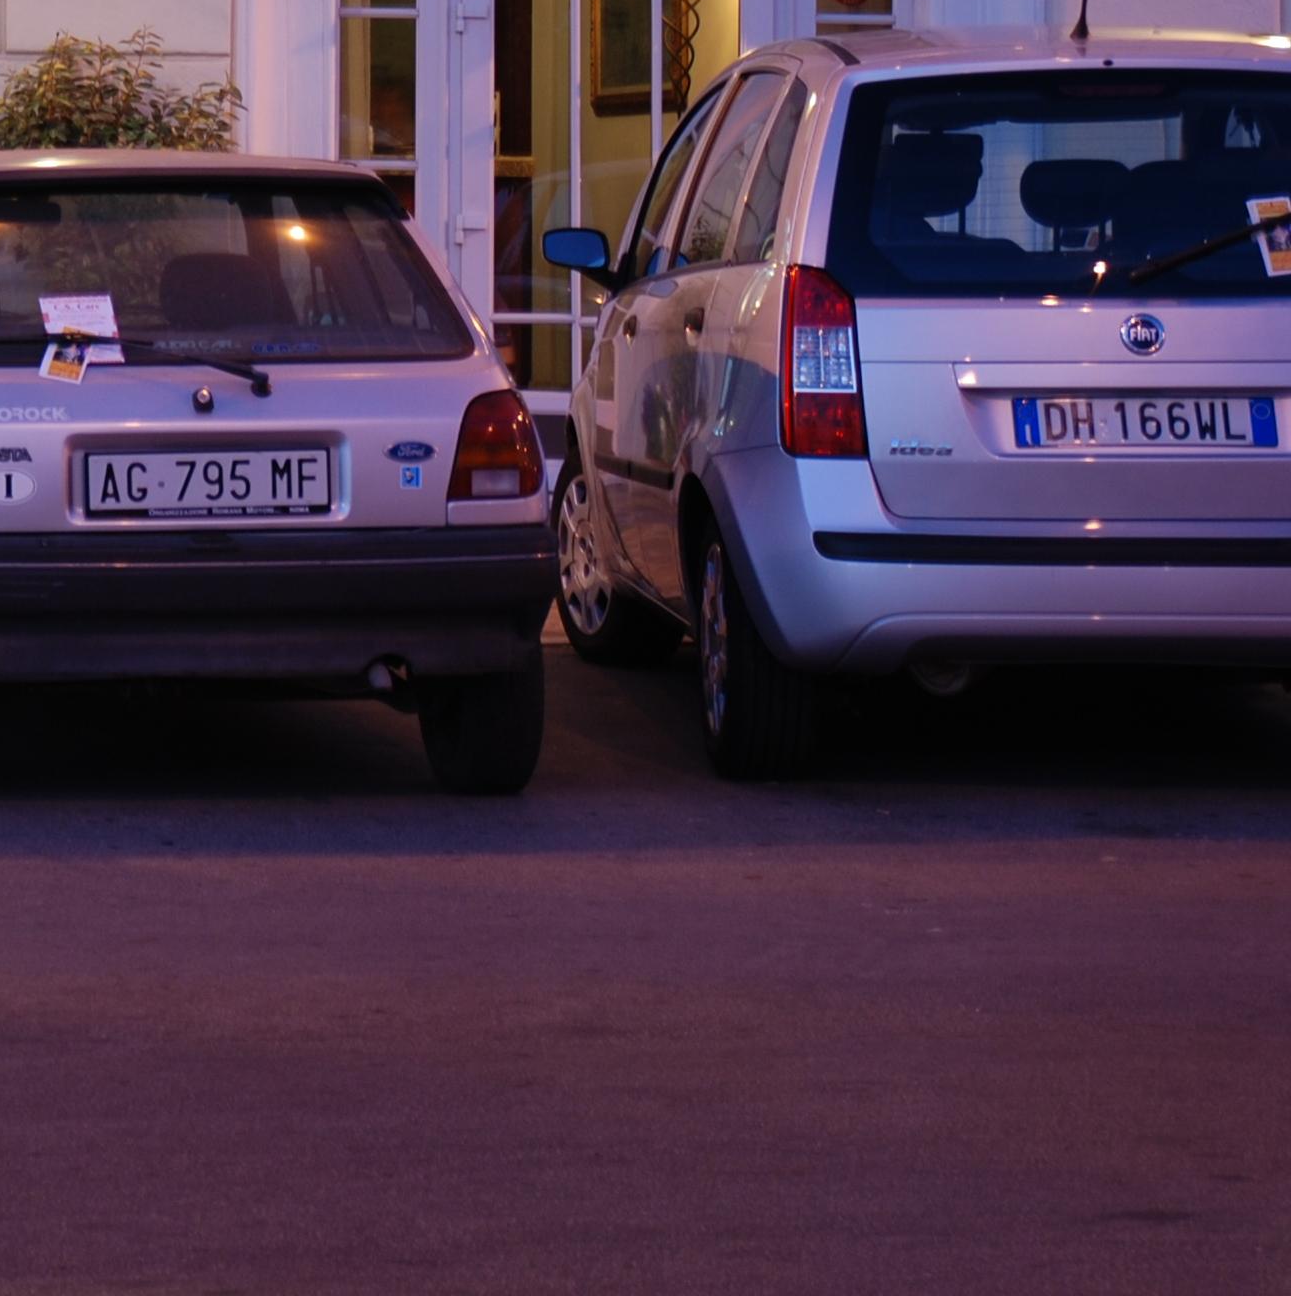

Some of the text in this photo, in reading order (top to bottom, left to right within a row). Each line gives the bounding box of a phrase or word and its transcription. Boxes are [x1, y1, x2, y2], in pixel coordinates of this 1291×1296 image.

[1129, 325, 1157, 343] FIAT
[1044, 402, 1095, 442] DH
[100, 454, 319, 504] AG 795 MF
